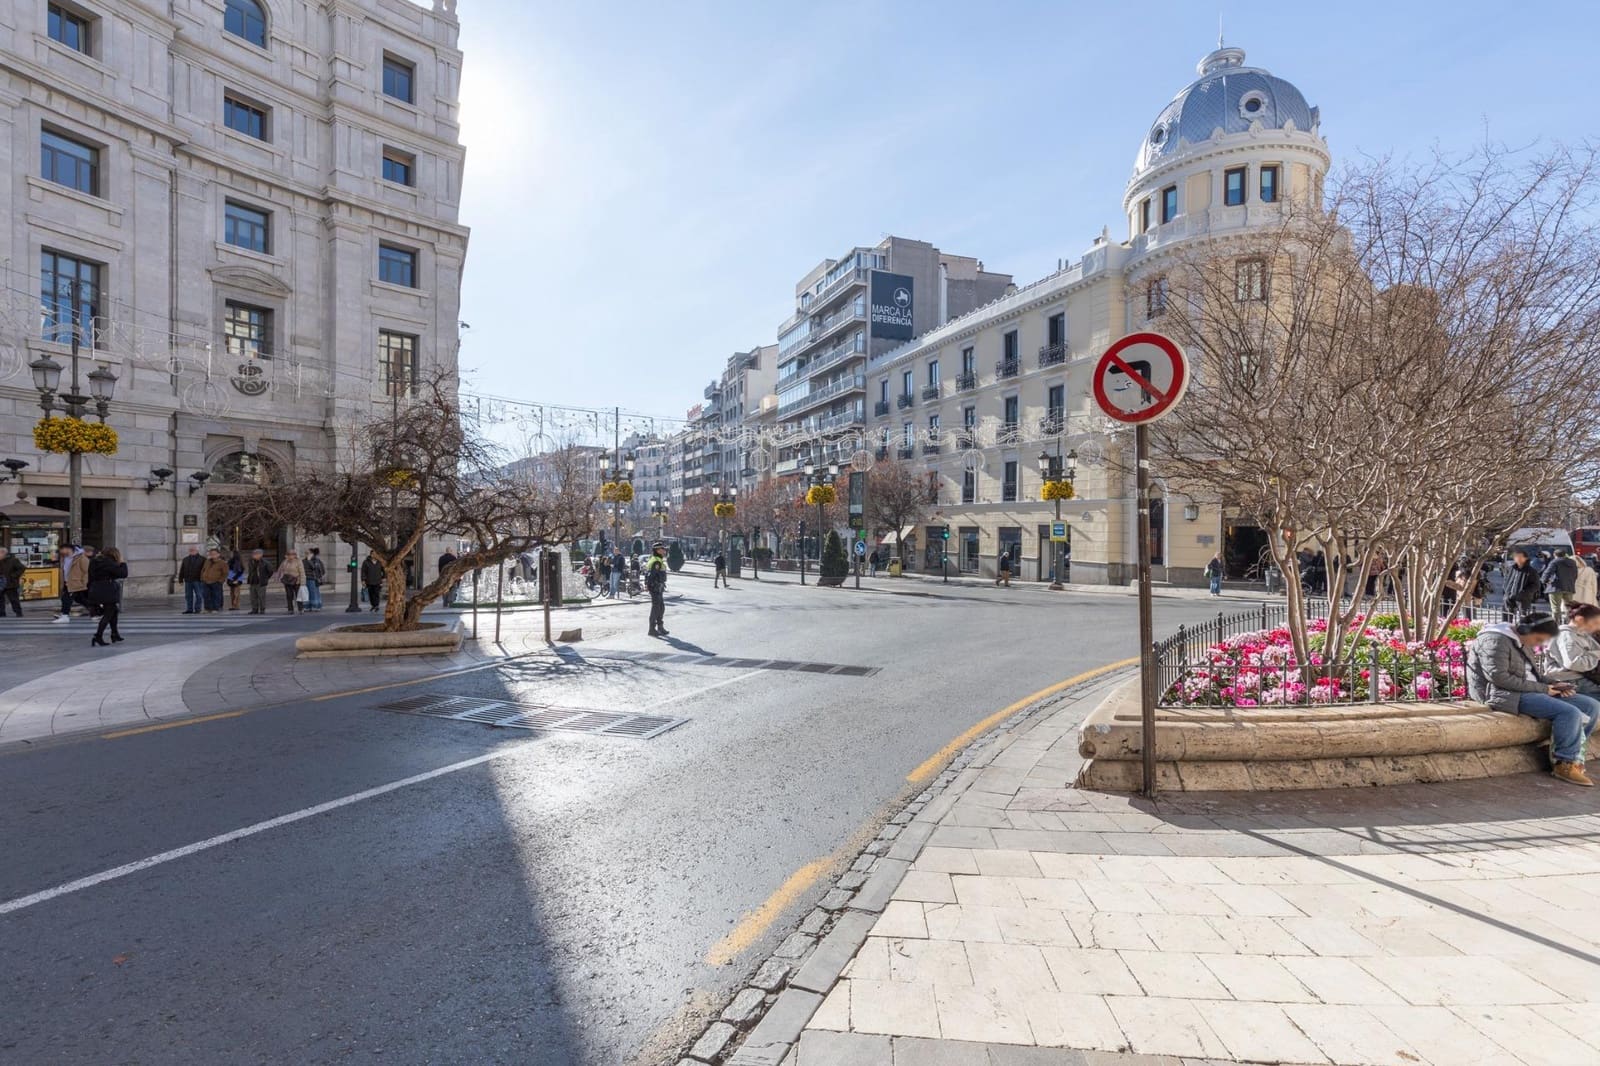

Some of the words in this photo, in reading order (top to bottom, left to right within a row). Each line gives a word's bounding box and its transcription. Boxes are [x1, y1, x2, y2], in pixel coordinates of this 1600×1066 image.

[872, 304, 901, 317] MARCA
[902, 308, 912, 319] LA
[872, 314, 912, 326] DIFERENCIA
